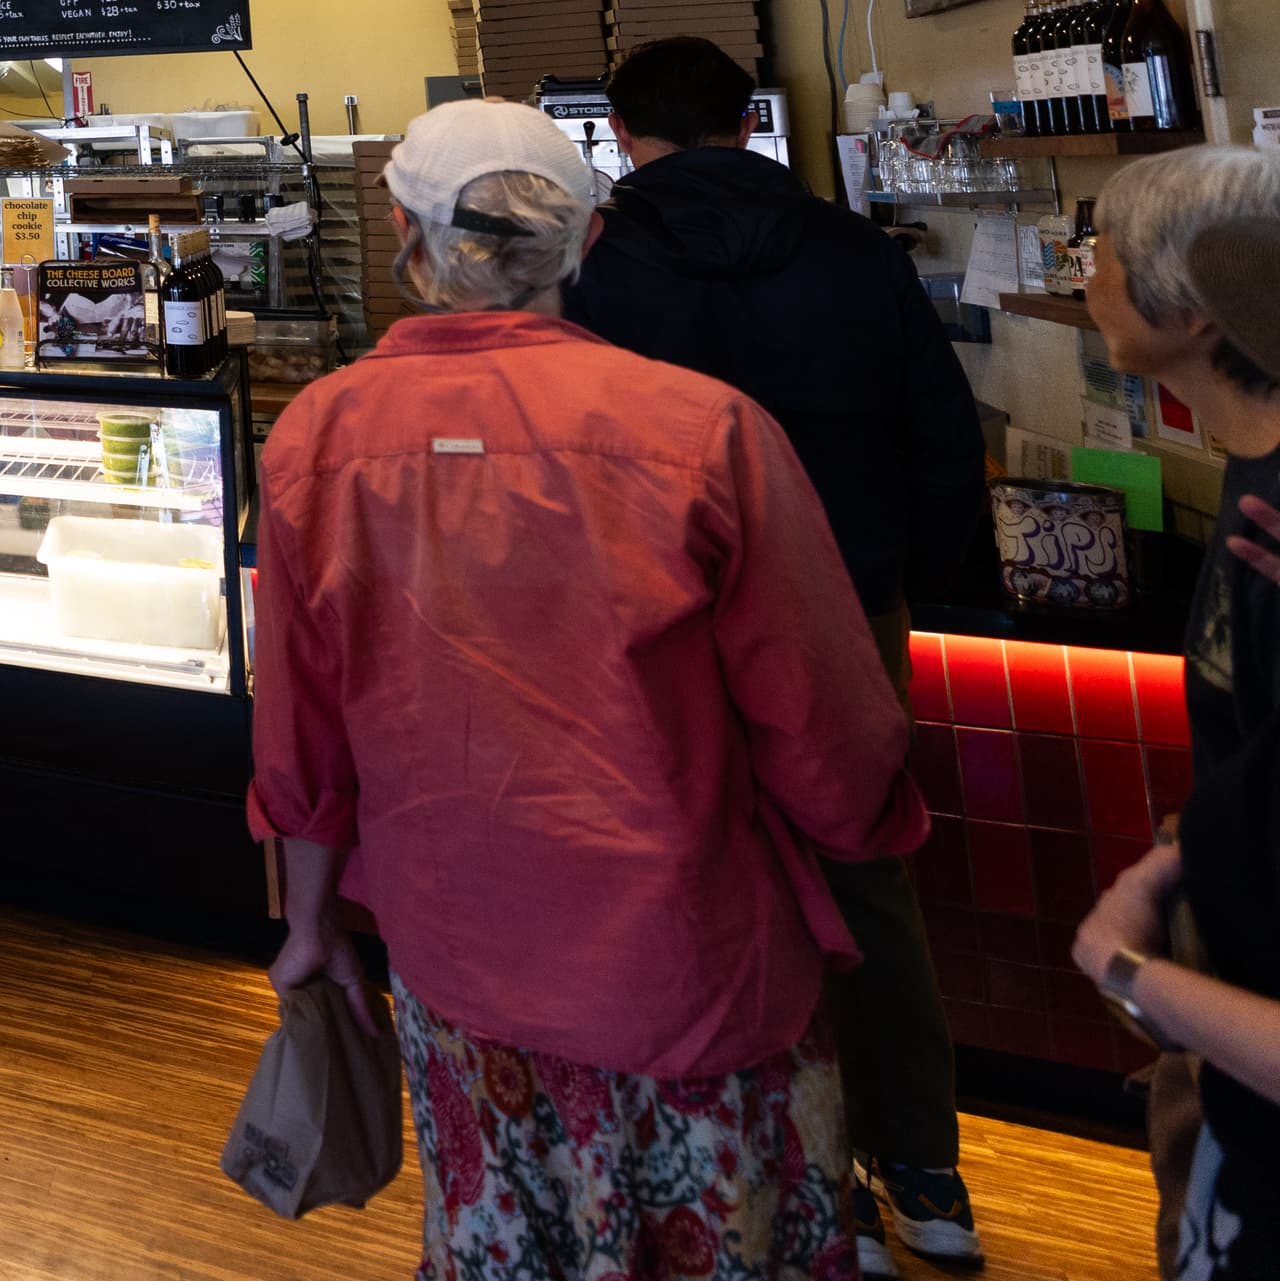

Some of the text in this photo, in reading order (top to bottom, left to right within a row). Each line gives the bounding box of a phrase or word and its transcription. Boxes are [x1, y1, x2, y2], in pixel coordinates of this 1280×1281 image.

[61, 9, 92, 19] VEGAN
[4, 201, 48, 210] chocolate
[17, 211, 37, 221] chip
[12, 221, 42, 231] cookie
[15, 231, 40, 241] $3.50
[46, 267, 135, 279] THE CHEESE BOARD
[46, 277, 136, 288] COLLECTIVE WORKS
